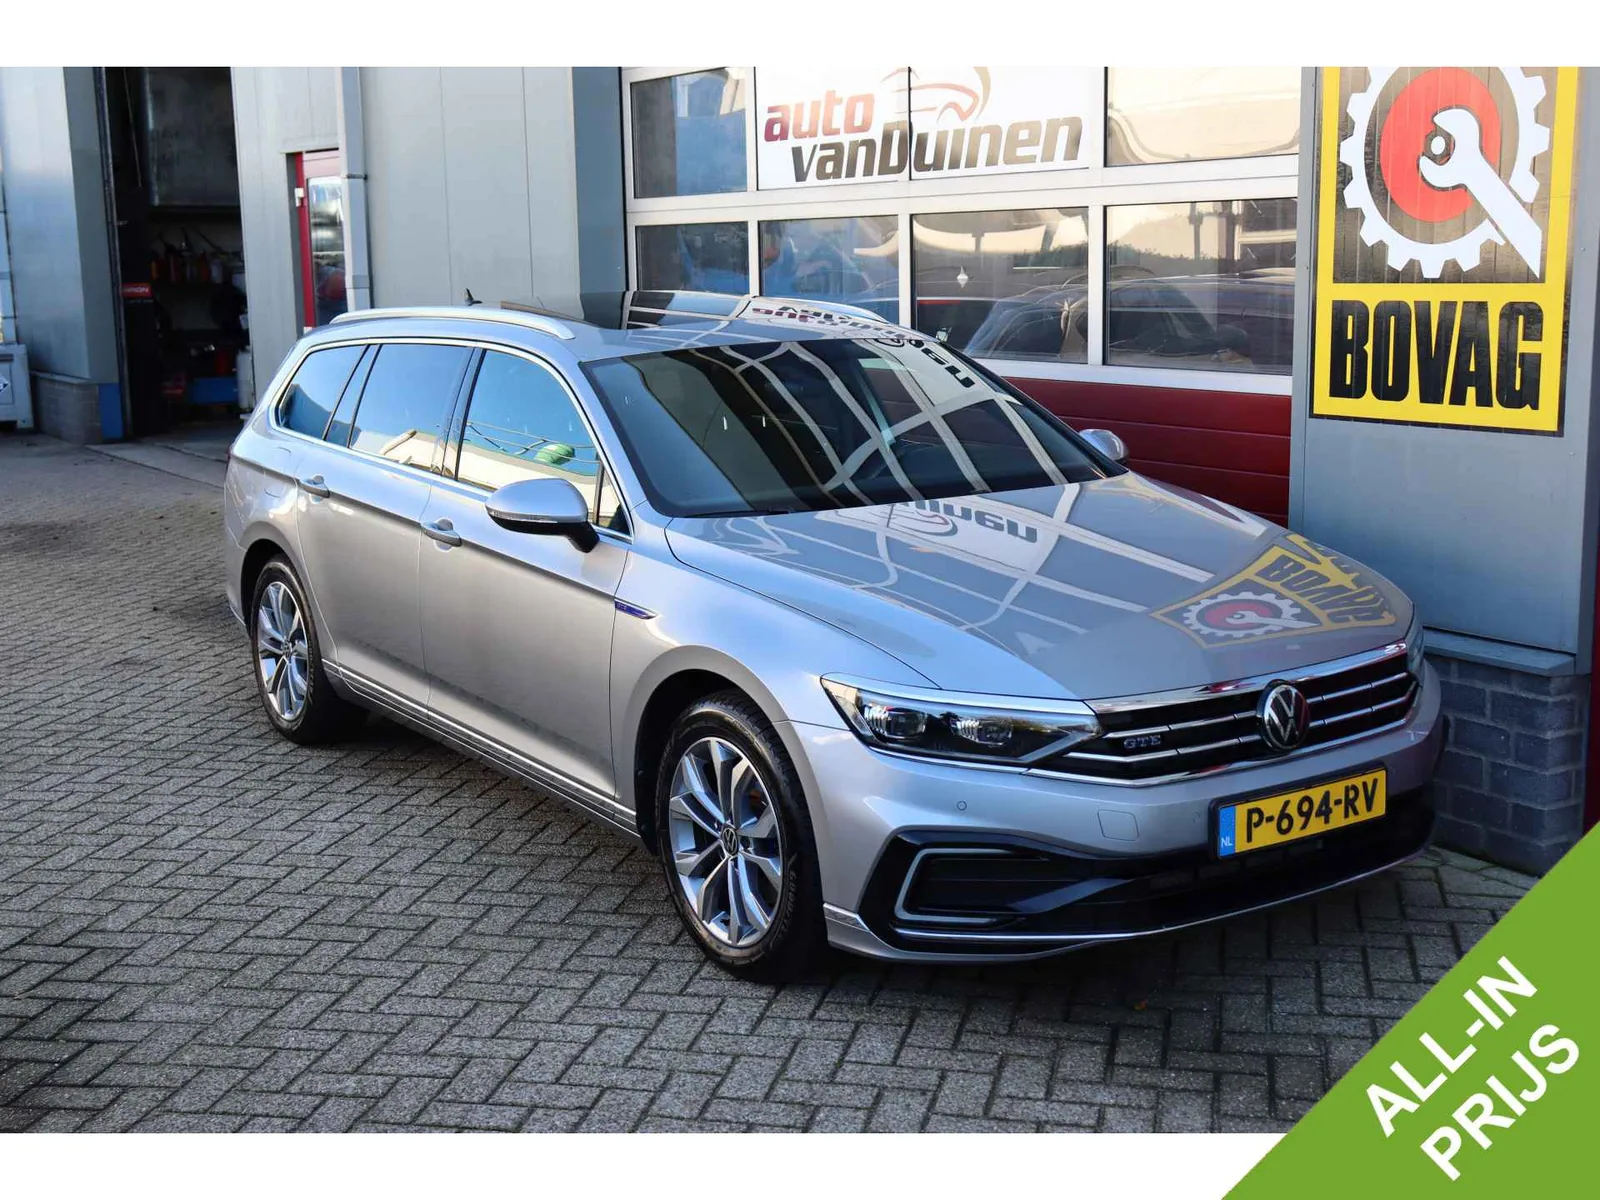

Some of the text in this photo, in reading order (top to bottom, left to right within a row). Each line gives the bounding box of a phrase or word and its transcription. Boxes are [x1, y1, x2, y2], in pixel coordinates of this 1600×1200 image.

[764, 90, 875, 142] auto
[791, 116, 1083, 182] vanDuinen
[1329, 299, 1544, 411] BOVAG
[1123, 734, 1161, 749] GTE
[1246, 777, 1379, 843] P-694-RV
[1220, 836, 1234, 847] NL
